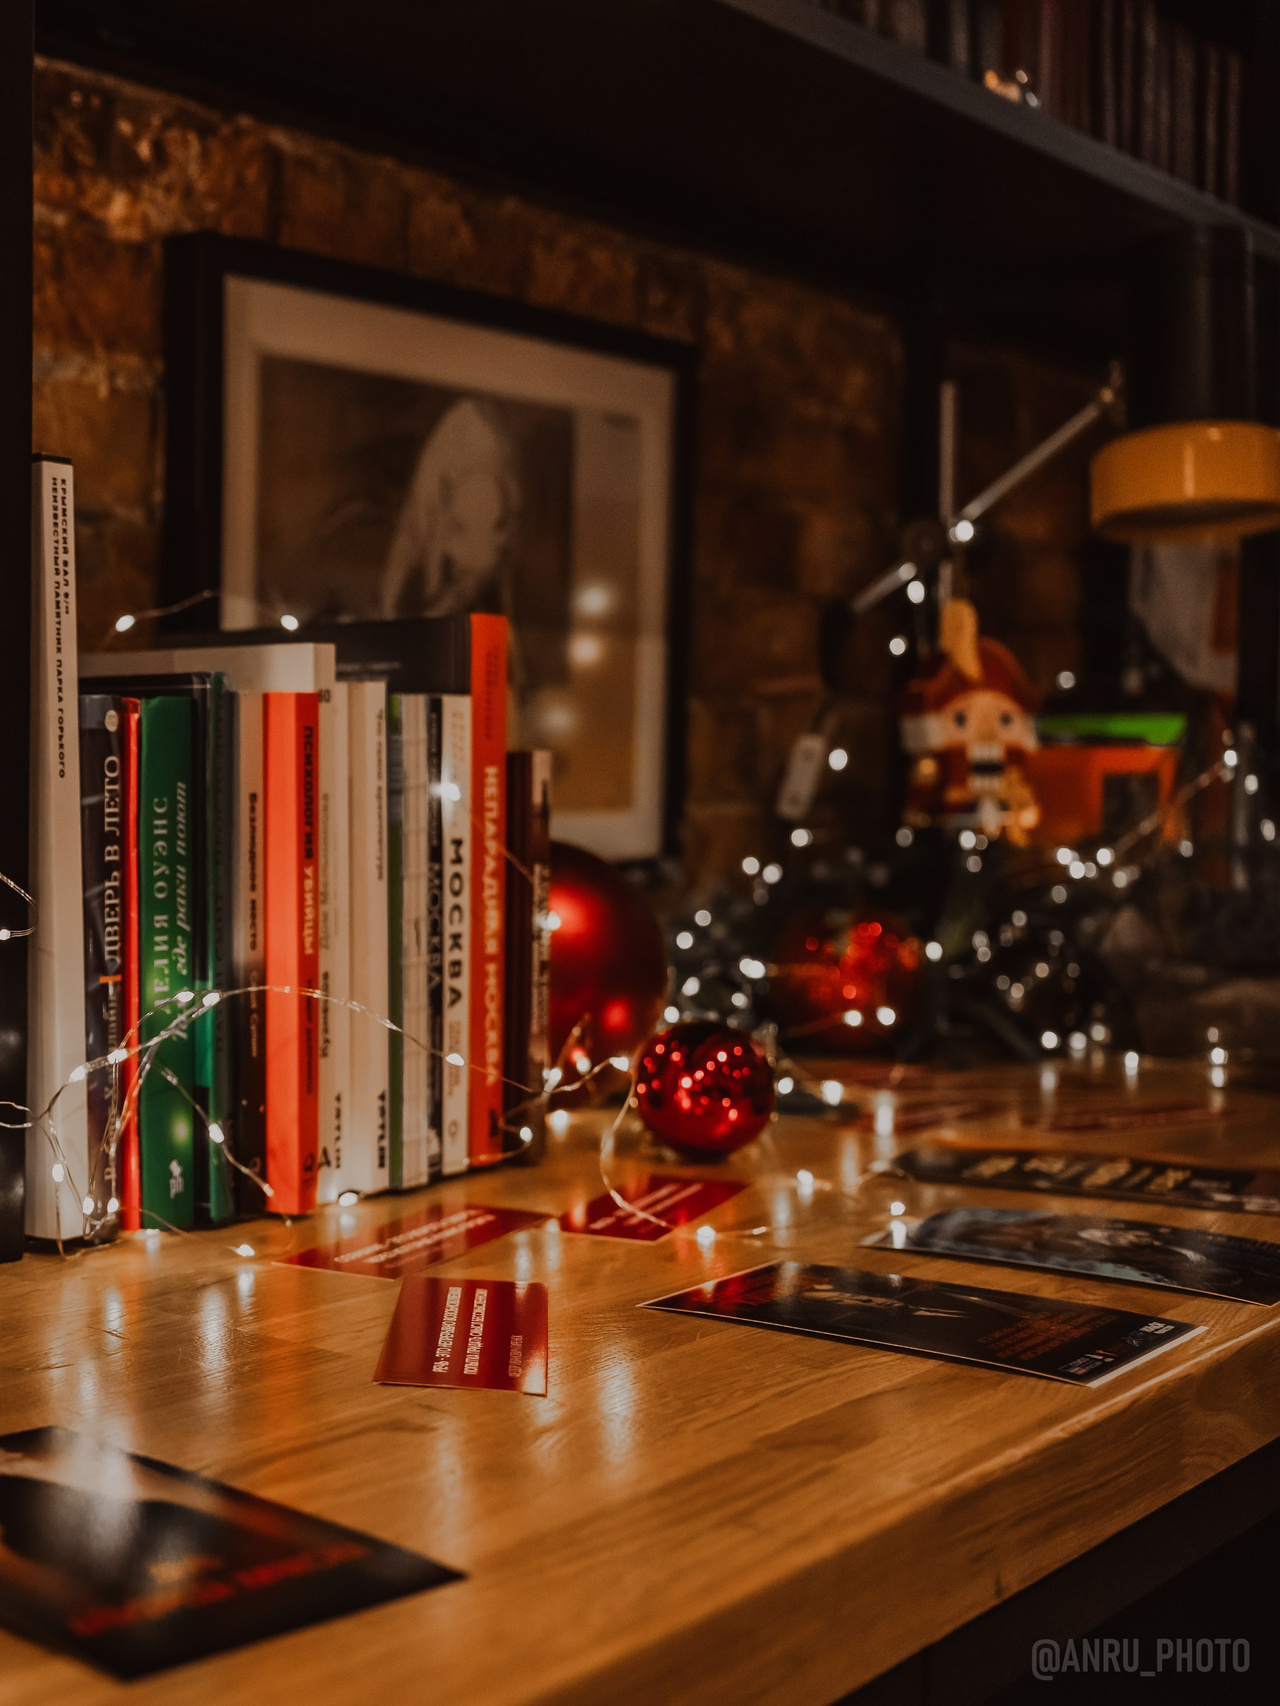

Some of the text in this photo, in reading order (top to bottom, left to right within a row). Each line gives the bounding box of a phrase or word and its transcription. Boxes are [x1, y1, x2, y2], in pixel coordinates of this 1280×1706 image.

[61, 477, 70, 556] КРЫМСКИЙ
[62, 559, 70, 588] ВАЛ
[52, 476, 66, 779] НЕИЗВЕСТНЫЙ ПАМЯТНИК ПАРКА ГОРЬКОГО
[104, 755, 122, 965] ДВЕРЬ В ЛЕТО
[152, 796, 171, 900] ОУЭНС
[302, 865, 315, 956] УБИЙЦЫ
[447, 837, 464, 1009] МОСКВА
